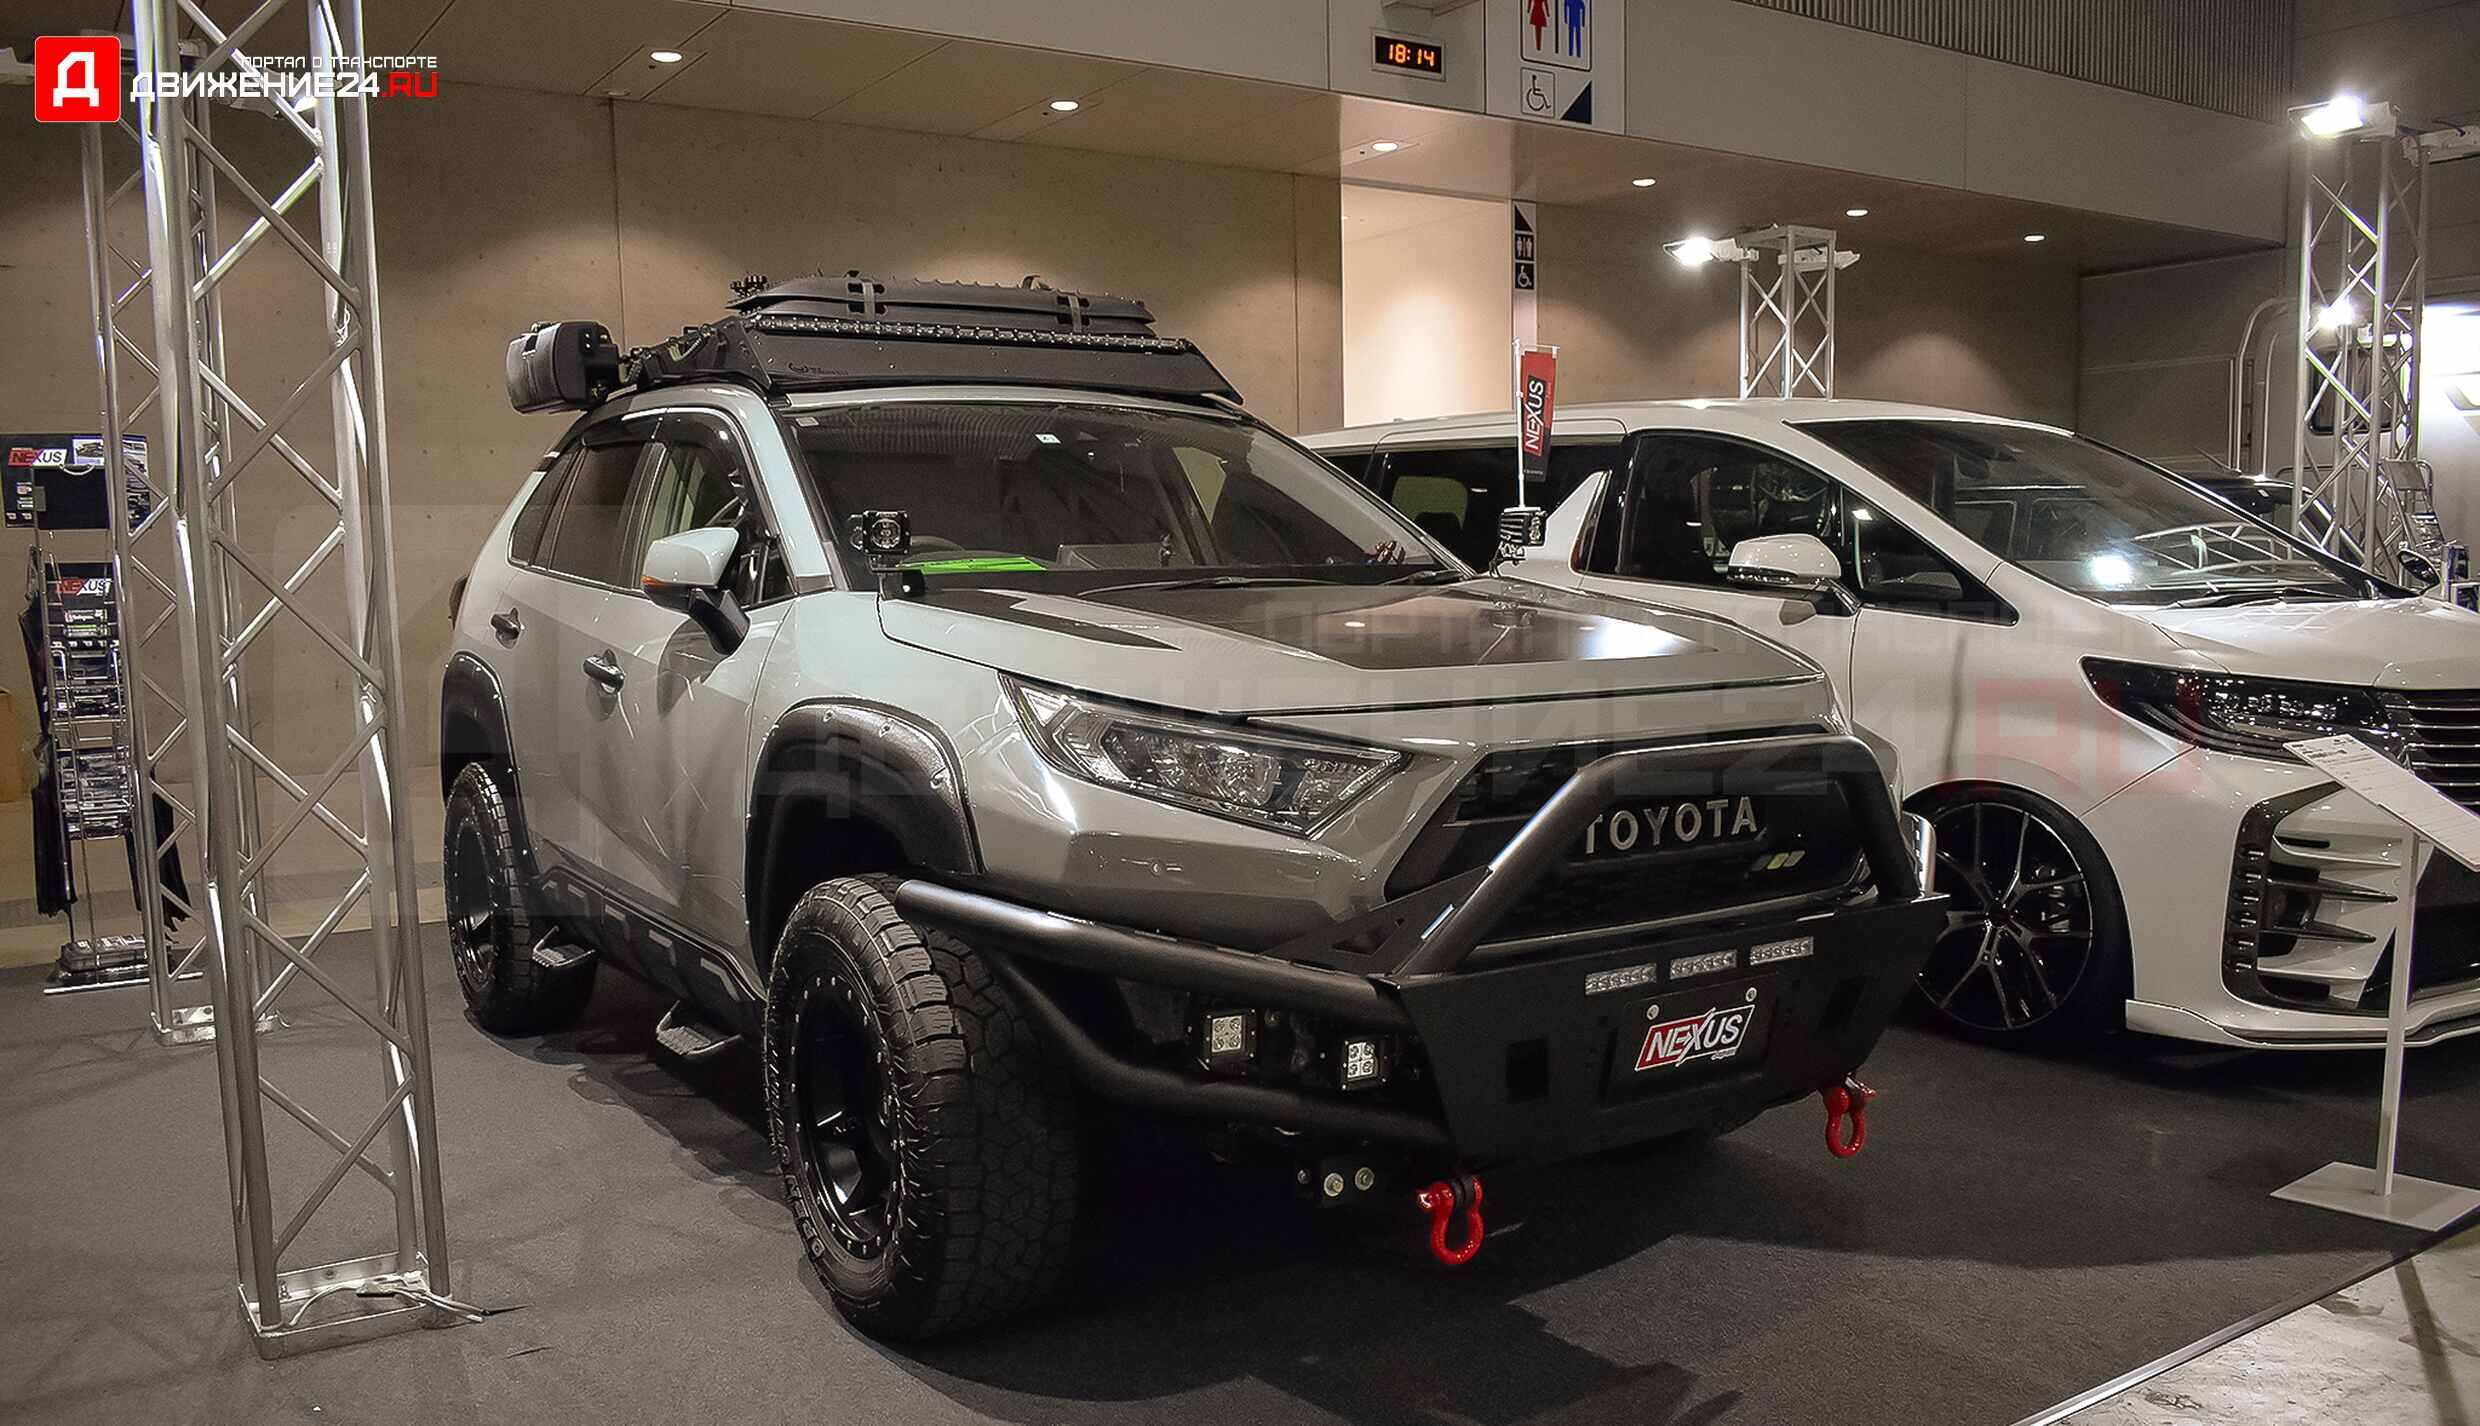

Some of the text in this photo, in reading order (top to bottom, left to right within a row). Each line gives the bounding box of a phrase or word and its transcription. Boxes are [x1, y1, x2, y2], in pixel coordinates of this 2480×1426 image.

[1388, 43, 1435, 67] 18:14
[1524, 380, 1544, 450] NEXUS
[12, 451, 62, 463] NEXUS
[1586, 796, 1757, 853] TOYOTA
[1646, 1007, 1743, 1066] NEXUS
